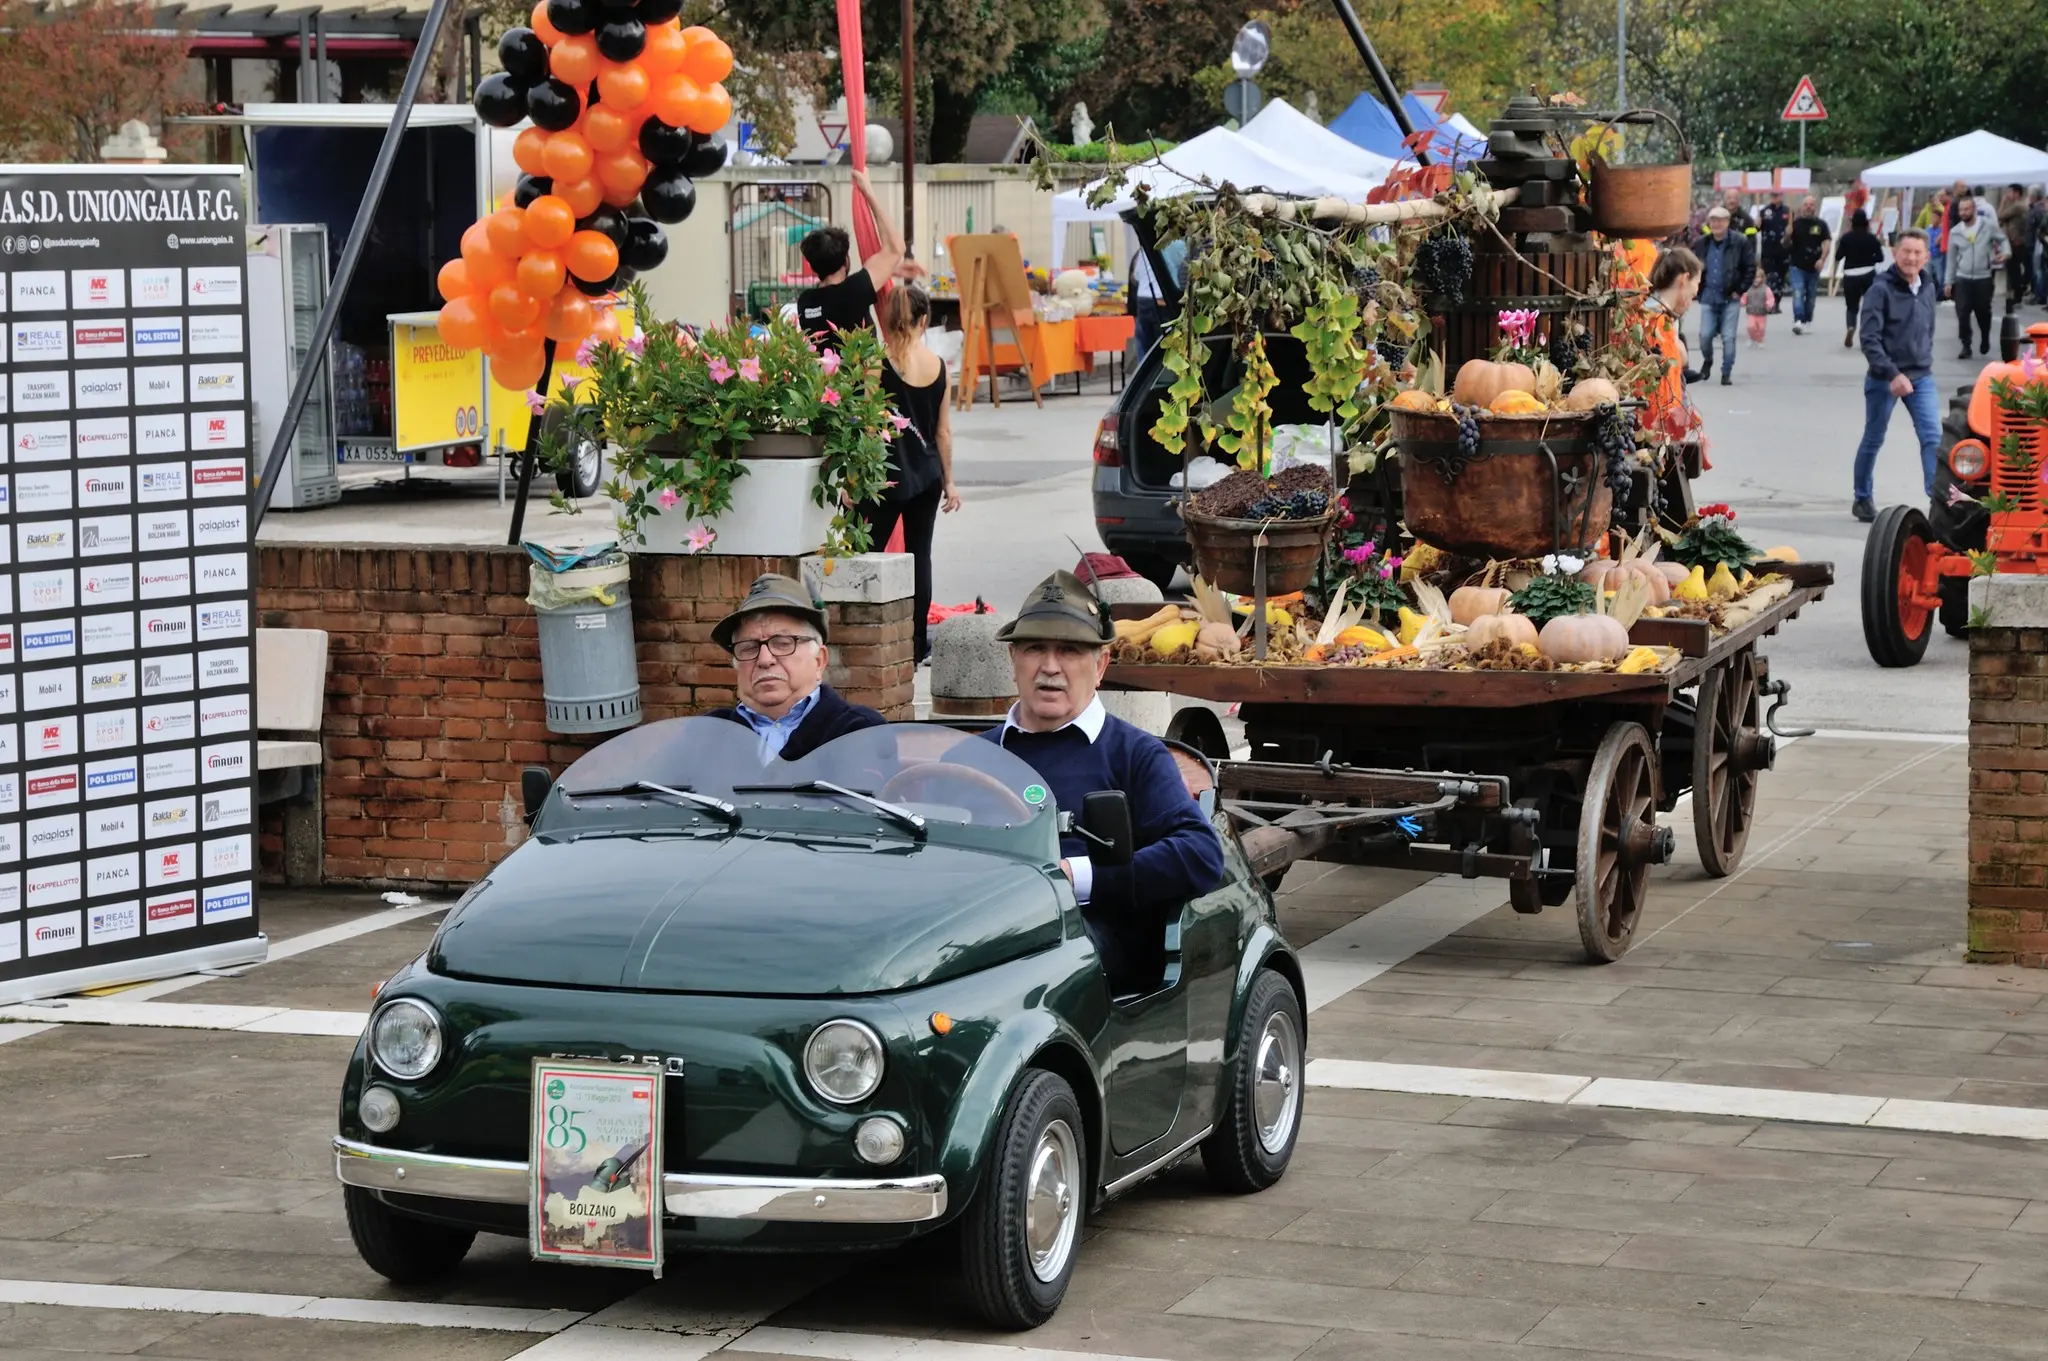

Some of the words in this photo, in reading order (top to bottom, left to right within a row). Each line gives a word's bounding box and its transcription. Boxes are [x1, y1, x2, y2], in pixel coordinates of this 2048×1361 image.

[1, 190, 63, 223] A.S.D.
[67, 189, 195, 222] UNIONGAIA
[197, 189, 239, 221] F.G.
[20, 286, 56, 296] PIANCA
[30, 331, 62, 339] REALE
[137, 332, 152, 341] POL
[153, 331, 178, 340] SISTEM
[81, 381, 122, 394] gaiaplast
[149, 380, 166, 390] Mobil
[166, 381, 170, 389] 4
[86, 432, 128, 441] CAPPELLOTTO
[145, 429, 176, 439] PIANCA
[346, 447, 361, 460] XA
[155, 472, 181, 480] REALE
[199, 518, 240, 532] gaiaplast
[149, 573, 189, 583] CAPPELLOTTO
[203, 568, 236, 578] PIANCA
[212, 610, 241, 619] REALE
[26, 636, 42, 646] POL
[44, 633, 71, 644] SISTEM
[39, 684, 57, 695] Mobil
[57, 684, 62, 692] 4
[208, 709, 248, 720] CAPPELLOTTO
[89, 776, 104, 785] POL
[106, 771, 133, 782] SISTEM
[100, 822, 118, 832] Mobil
[119, 821, 124, 829] 4
[32, 828, 74, 844] gaiaplast
[96, 869, 130, 880] PIANCA
[36, 878, 79, 890] CAPPELLOTTO
[206, 900, 221, 909] POL
[223, 895, 248, 906] SISTEM
[106, 910, 134, 921] REALE
[569, 1203, 616, 1218] BOLZANO
